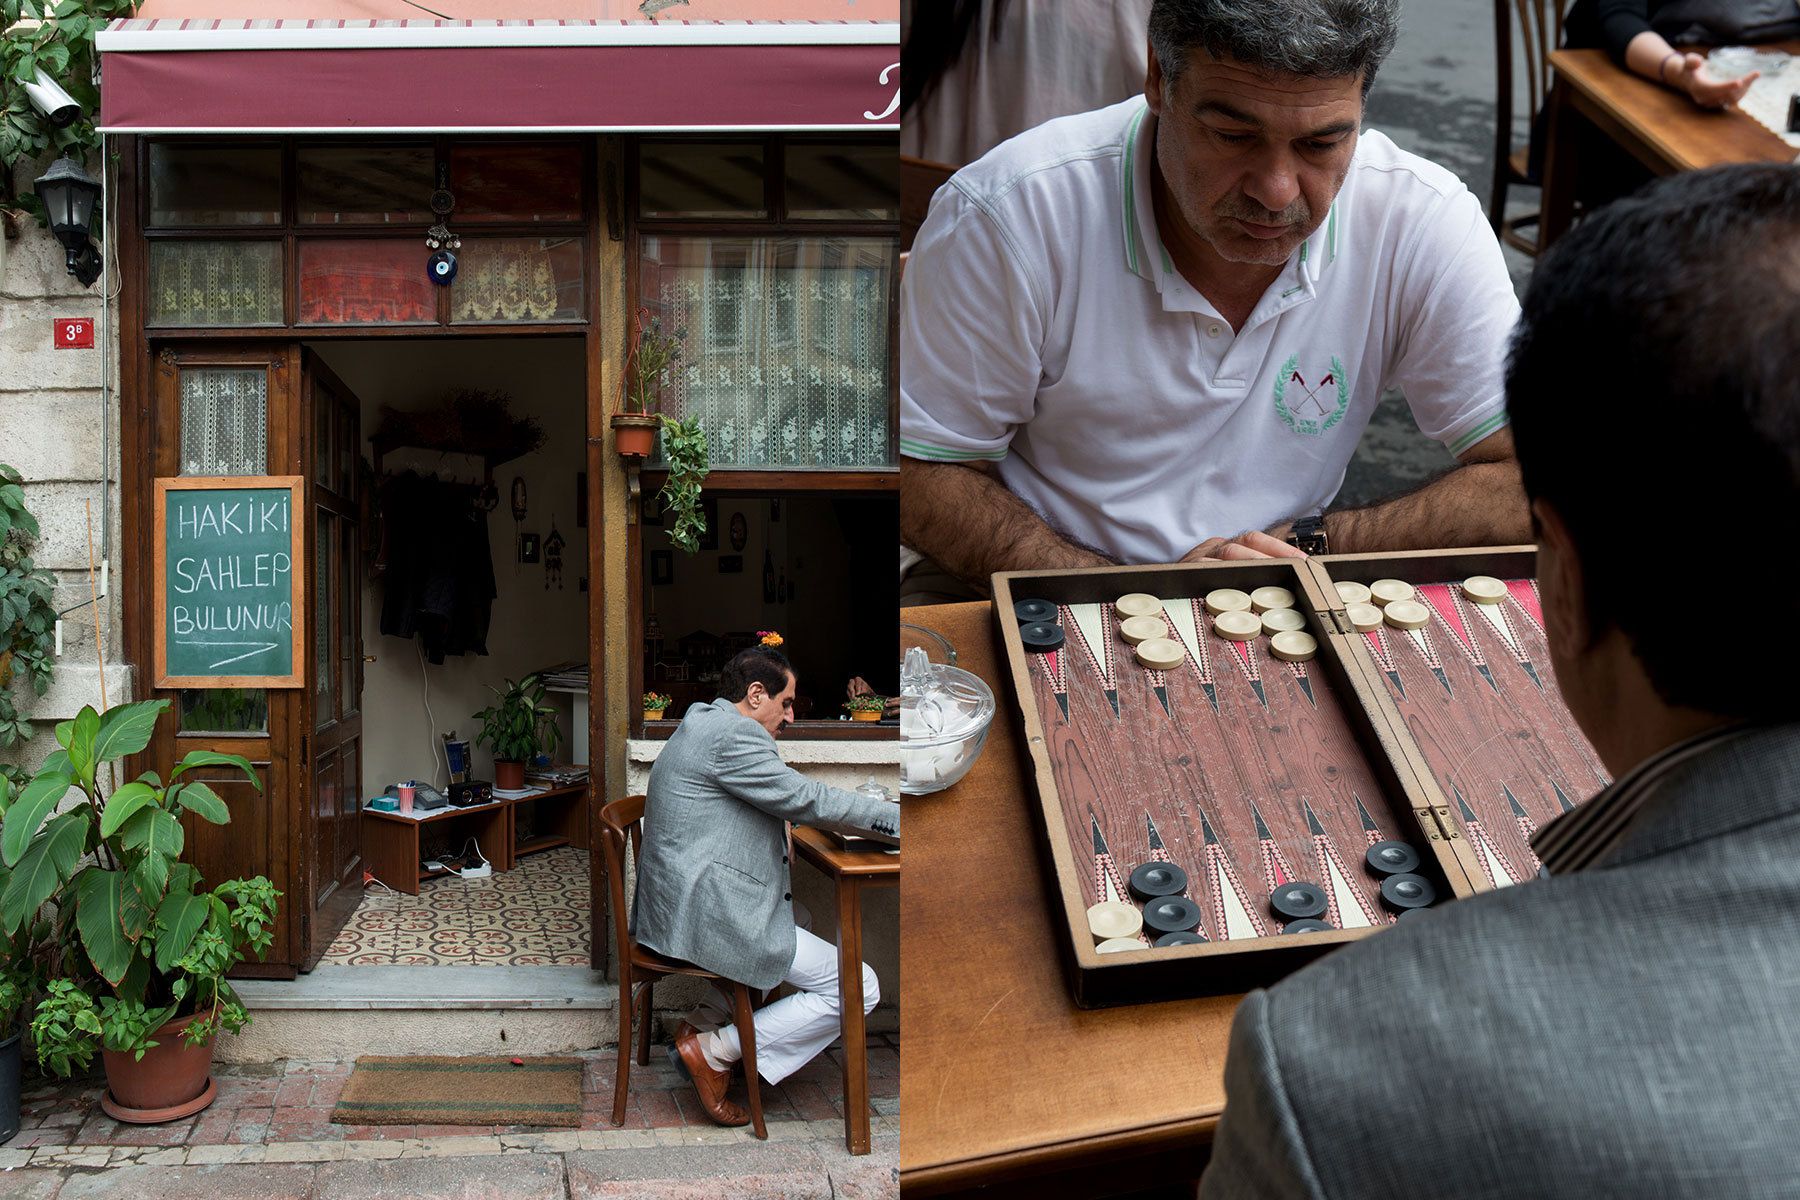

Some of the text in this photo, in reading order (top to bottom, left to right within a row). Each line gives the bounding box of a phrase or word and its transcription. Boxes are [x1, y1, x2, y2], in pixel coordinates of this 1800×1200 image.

[66, 324, 83, 341] 3B
[174, 552, 291, 593] SAHLEP
[173, 601, 292, 634] BULUNUR
